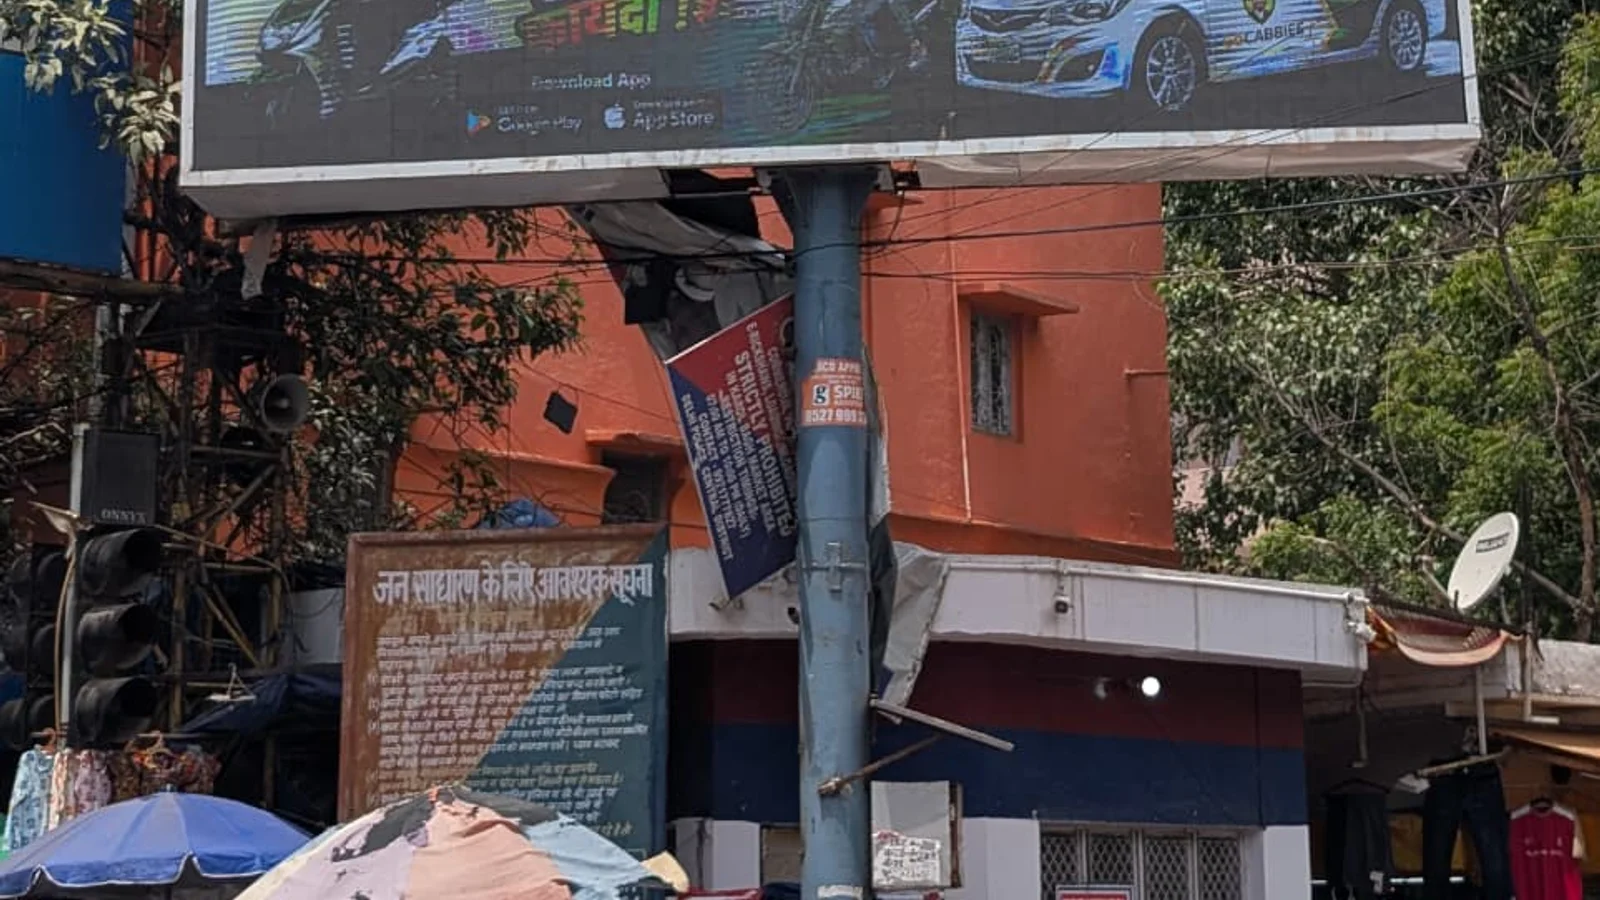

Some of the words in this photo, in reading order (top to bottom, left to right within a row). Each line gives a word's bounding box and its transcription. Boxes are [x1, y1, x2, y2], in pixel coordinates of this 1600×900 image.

[617, 72, 652, 90] App
[670, 110, 715, 127] Store
[697, 410, 719, 463] CONTACT
[732, 349, 768, 434] STRICTLY
[754, 431, 796, 539] PROHIBITED
[372, 570, 410, 606] जन
[412, 568, 480, 605] साधारण
[480, 560, 502, 603] के
[536, 566, 608, 604] आवश्यक
[608, 563, 654, 607] सूचना
